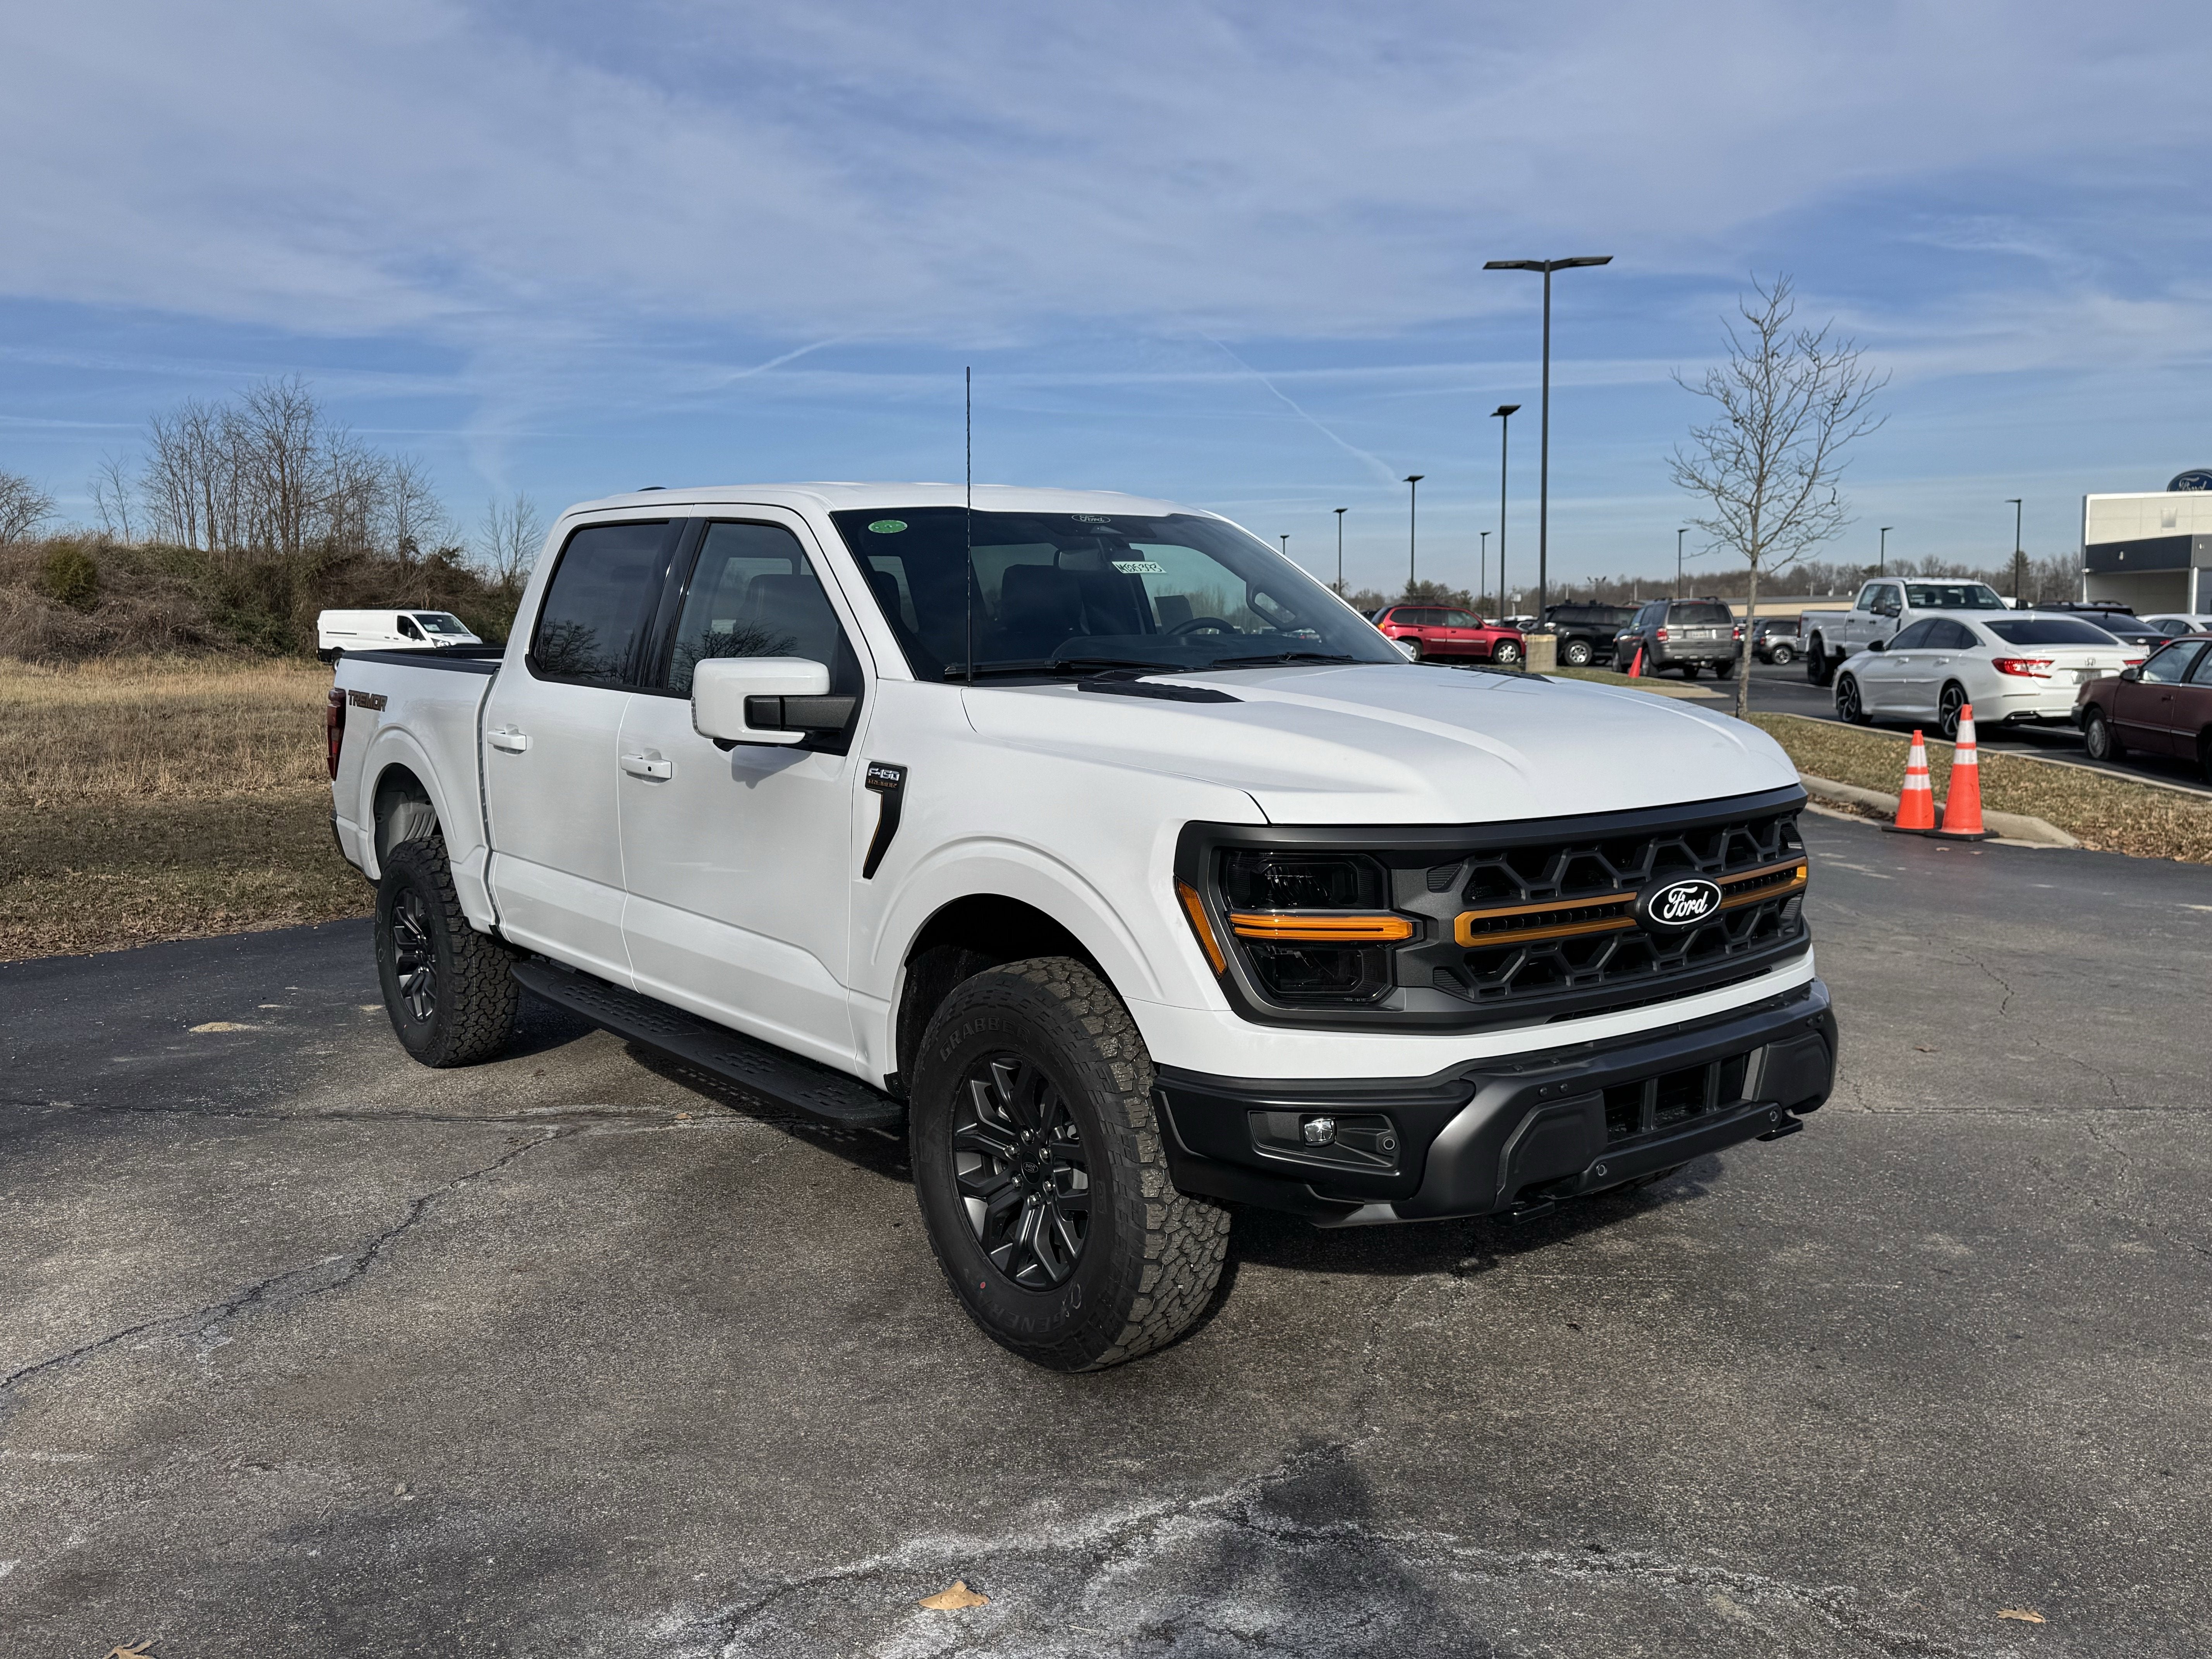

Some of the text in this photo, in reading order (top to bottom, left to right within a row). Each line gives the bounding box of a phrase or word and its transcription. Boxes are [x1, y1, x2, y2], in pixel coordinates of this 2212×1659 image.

[348, 690, 388, 712] TREMOR
[1663, 885, 1709, 919] Ford
[939, 1017, 1030, 1062] GRABBER
[970, 1279, 1066, 1333] GENERA
